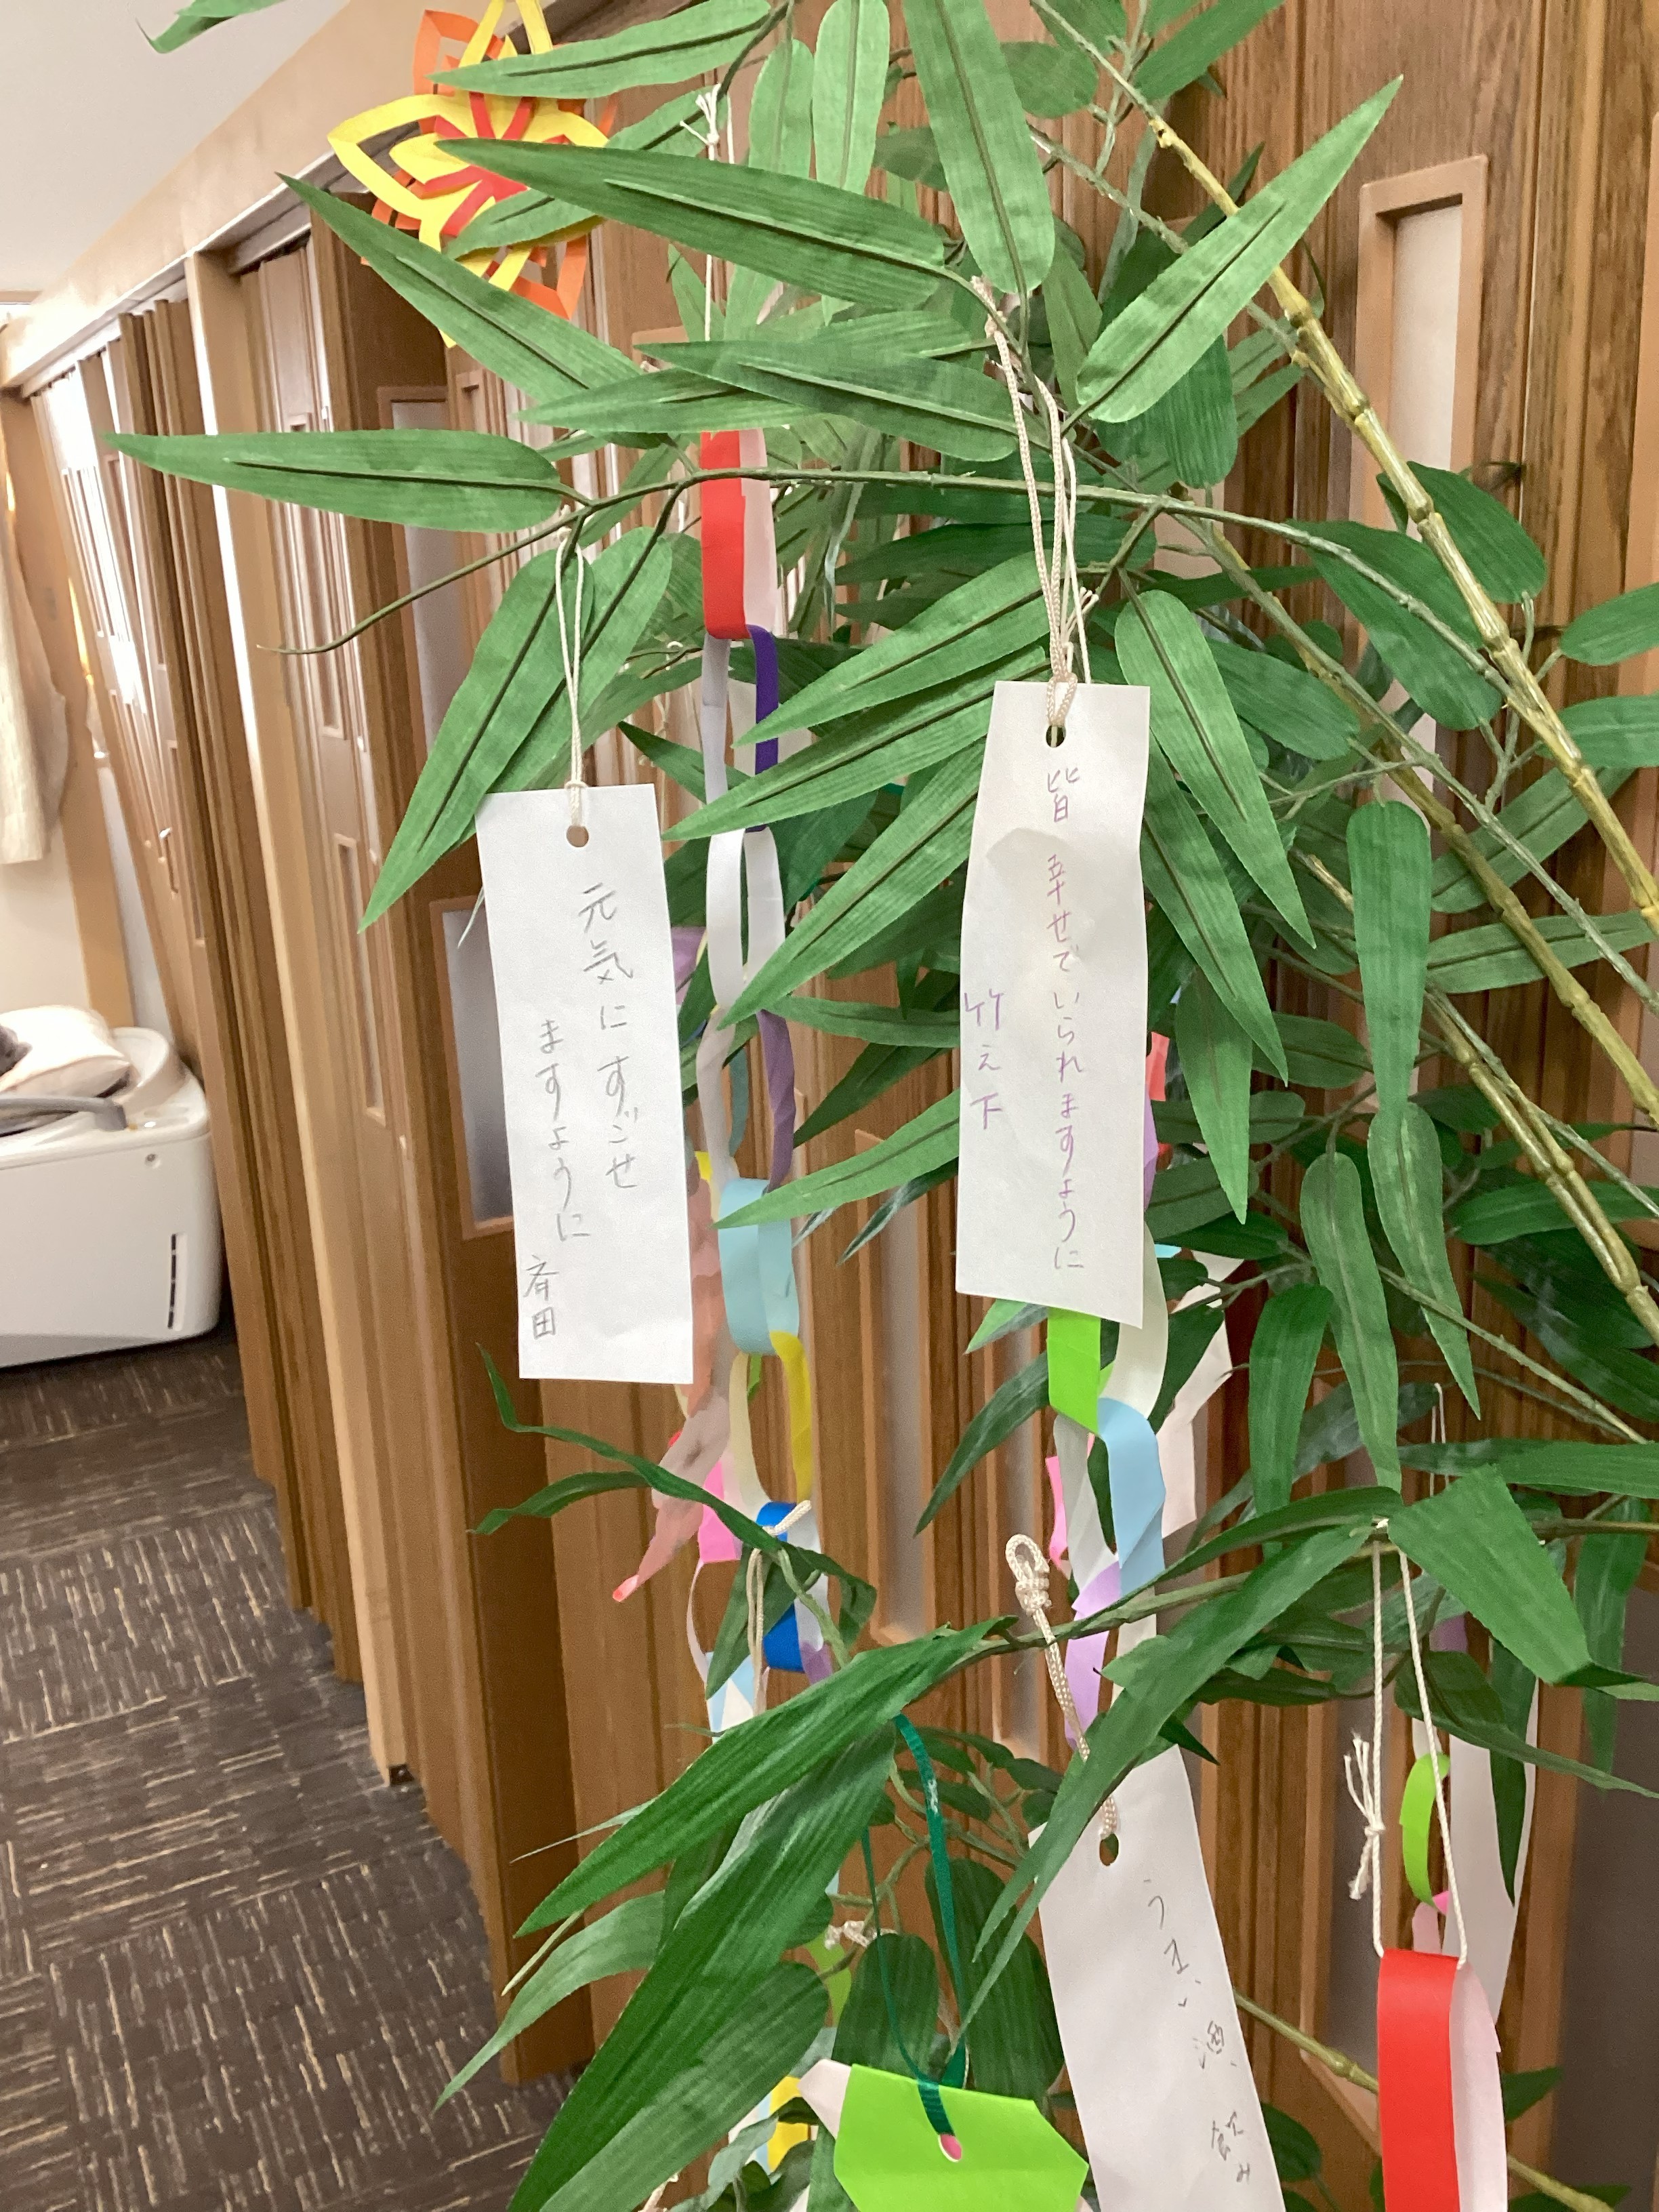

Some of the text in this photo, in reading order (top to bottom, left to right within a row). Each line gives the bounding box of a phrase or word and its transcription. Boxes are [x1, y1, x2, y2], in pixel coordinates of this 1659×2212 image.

[535, 1019, 591, 1242] ますように
[578, 882, 639, 1189] 元気にすごせ
